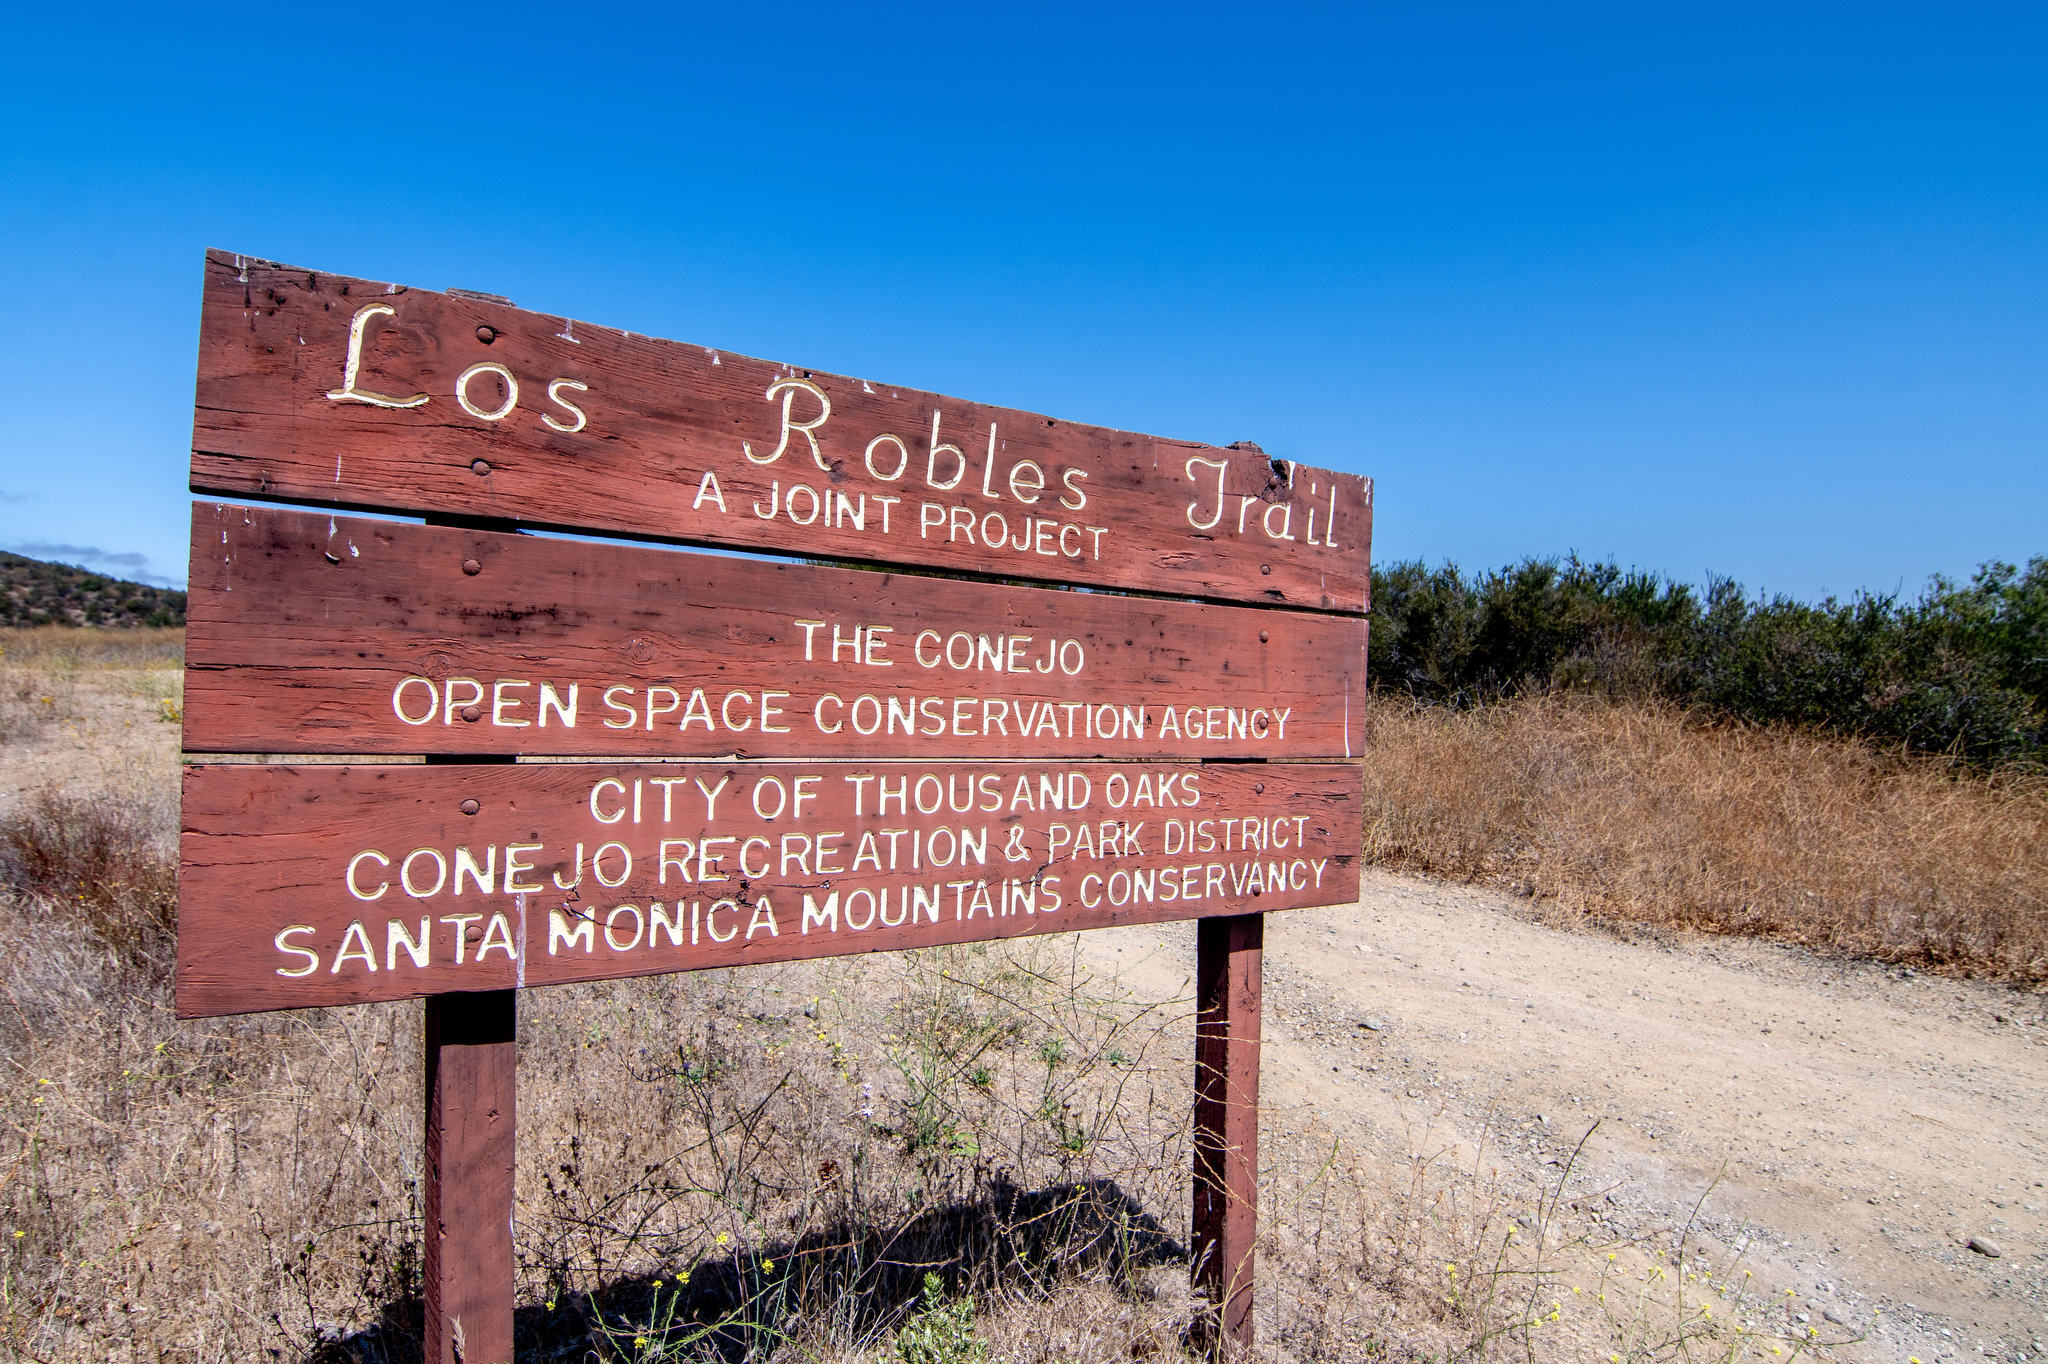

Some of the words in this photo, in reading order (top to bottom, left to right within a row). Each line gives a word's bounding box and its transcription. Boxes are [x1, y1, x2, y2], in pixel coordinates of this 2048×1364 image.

[325, 302, 588, 433] Los
[742, 377, 1089, 512] Robles
[1184, 455, 1339, 549] Trail
[692, 470, 728, 514] A
[753, 479, 901, 534] JOINT
[919, 501, 1109, 561] PROJECT
[794, 619, 895, 667] THE
[914, 627, 1085, 676] CONEJO
[392, 675, 579, 729] OPEN
[602, 684, 792, 733] SPACE
[813, 690, 1146, 738] CONSERVATION
[1157, 704, 1292, 740] AGENCY
[589, 775, 730, 824] CITY
[752, 774, 823, 821] OF
[843, 771, 1093, 817] THOUSAND
[1105, 771, 1202, 808] OAKS
[345, 840, 632, 901] CONEJO
[658, 824, 988, 884] RECREATION
[1004, 823, 1031, 863] &
[1048, 819, 1145, 861] PARK
[1164, 815, 1311, 856] DISTRICT
[273, 909, 520, 978] SANTA
[547, 893, 779, 957] MONICA
[800, 873, 1063, 937] MOUNTAINS
[1079, 857, 1328, 910] CONSERVANCY
